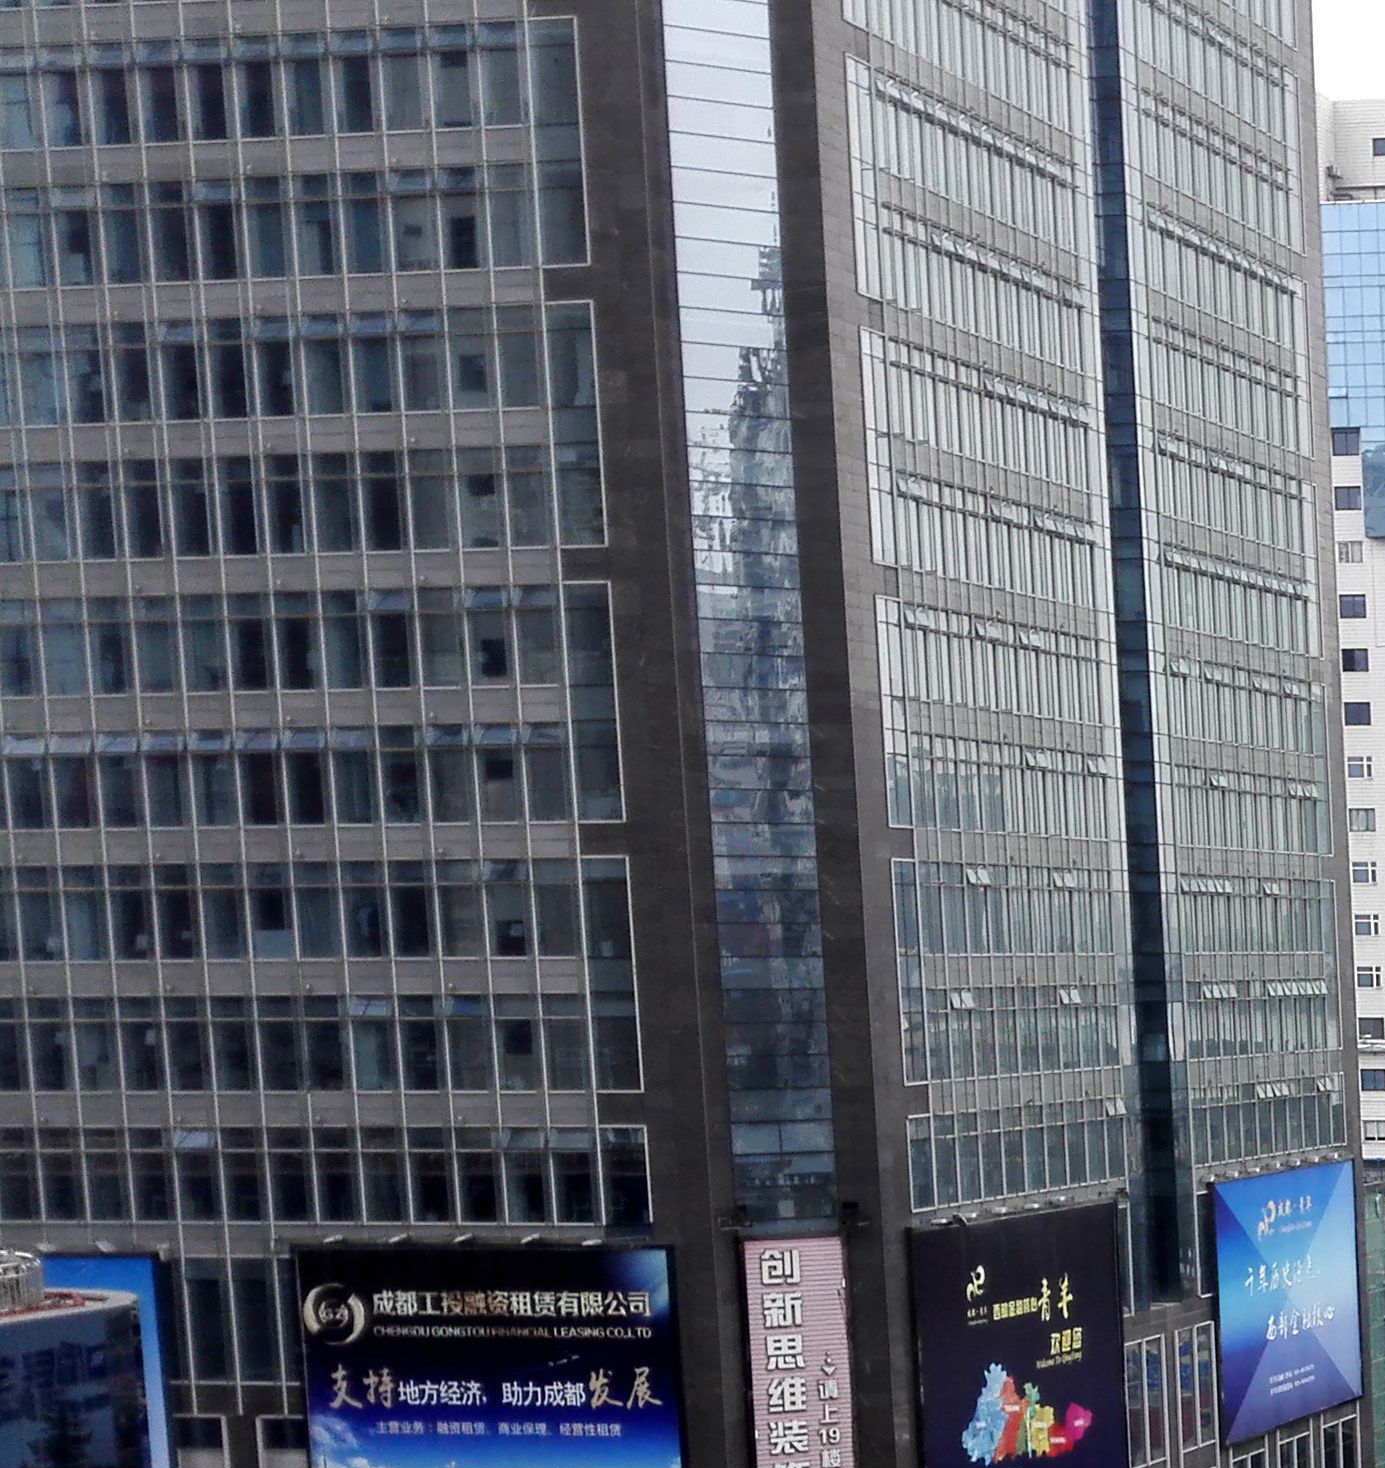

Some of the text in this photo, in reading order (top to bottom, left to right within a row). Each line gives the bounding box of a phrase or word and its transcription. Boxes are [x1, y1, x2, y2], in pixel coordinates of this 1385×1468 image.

[373, 1290, 652, 1318] 成都工投融资租赁有限公司
[554, 1327, 604, 1339] LEASING
